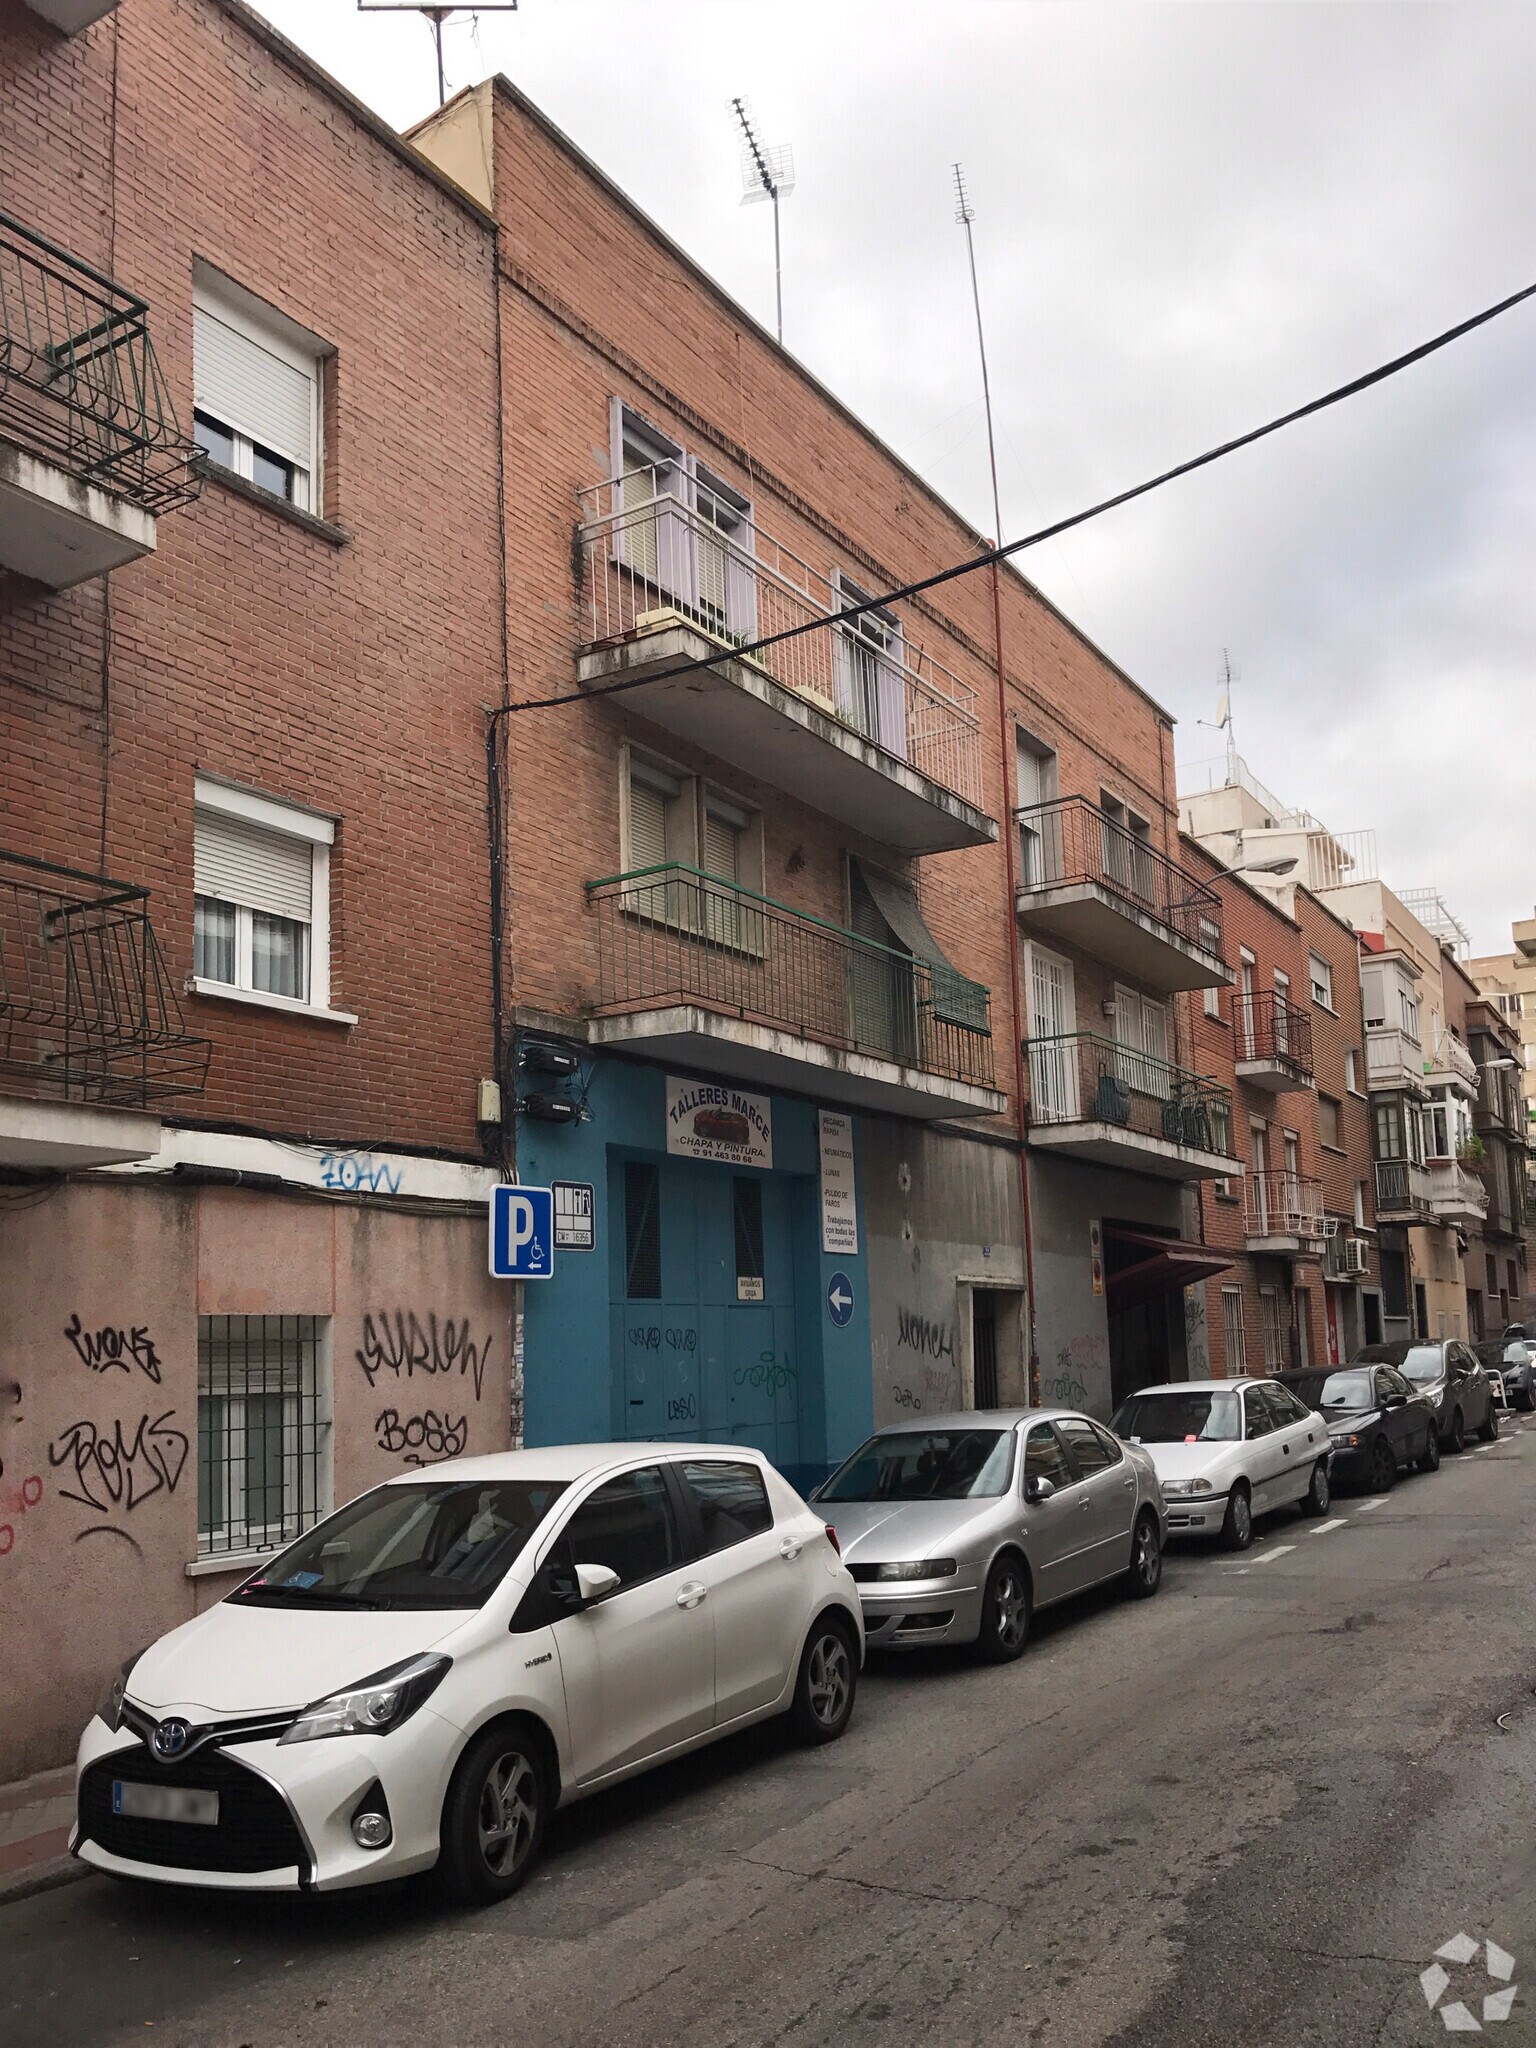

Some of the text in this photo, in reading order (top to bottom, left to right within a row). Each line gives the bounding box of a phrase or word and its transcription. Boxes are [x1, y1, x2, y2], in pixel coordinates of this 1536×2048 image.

[670, 1087, 770, 1143] TALLERES MARCE
[680, 1135, 763, 1157] CHAPA Y PINTURA
[703, 1149, 752, 1163] 91 463 80 68
[842, 1191, 848, 1199] DE
[825, 1200, 840, 1208] FAROS
[827, 1215, 853, 1226] Trabajamos
[508, 1196, 533, 1266] P
